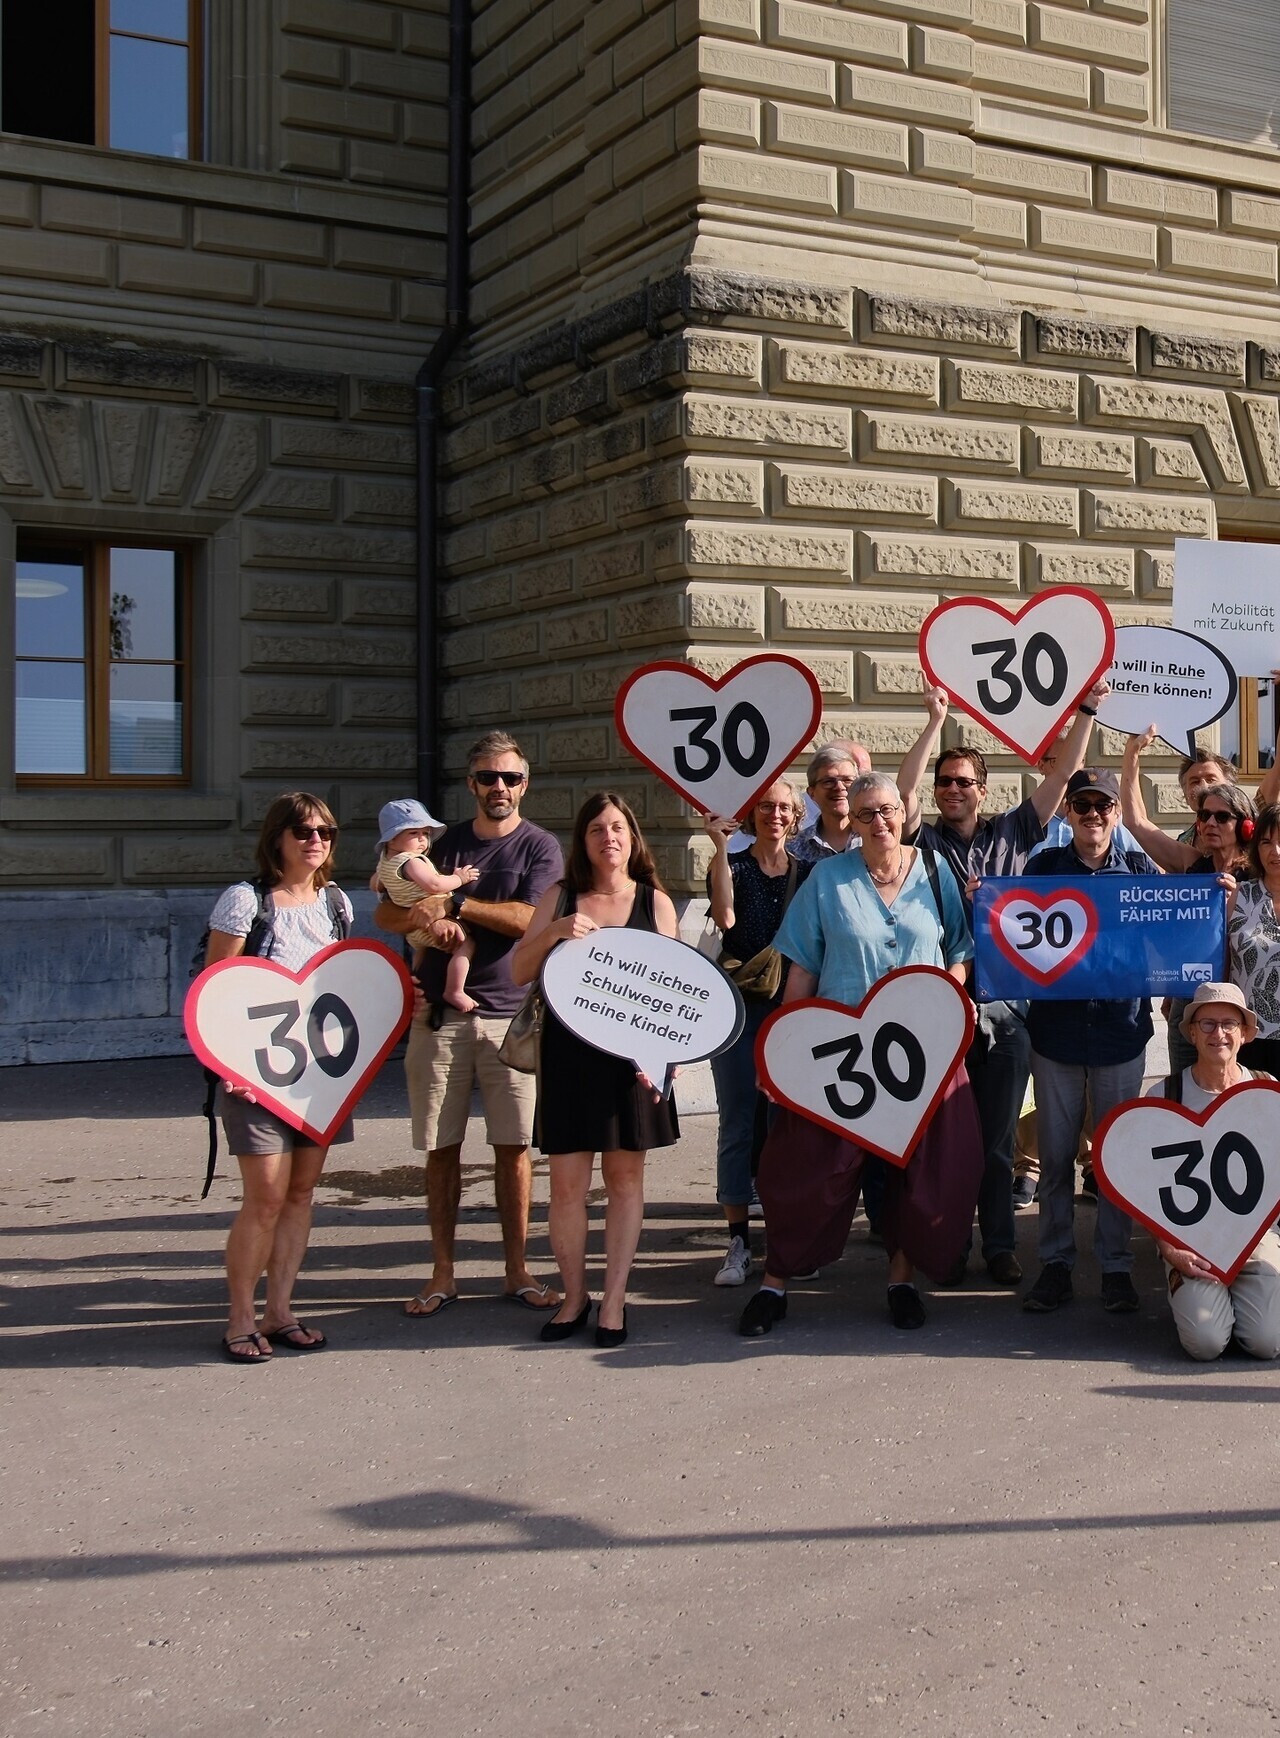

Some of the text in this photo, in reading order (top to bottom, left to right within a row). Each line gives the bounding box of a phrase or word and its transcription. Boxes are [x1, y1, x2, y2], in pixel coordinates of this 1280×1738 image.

[1193, 617, 1275, 633] mit Zukunft
[1211, 602, 1275, 618] Mobilität
[971, 631, 1068, 715] 30
[1122, 660, 1147, 672] will
[1151, 662, 1164, 674] in
[1168, 663, 1206, 678] Ruhe
[1153, 683, 1212, 699] können!
[669, 701, 770, 782] 30
[1119, 886, 1211, 903] RÜCKSICHT
[1120, 906, 1211, 922] FÄHRT MIT!
[1015, 910, 1073, 950] 30
[588, 946, 710, 1000] Ich will sichere
[1184, 969, 1212, 981] VCS
[582, 970, 703, 1023] Schulwege für
[247, 992, 360, 1088] 30
[573, 995, 693, 1046] meine Kinder!
[811, 1021, 927, 1120] 30
[1151, 1131, 1265, 1226] 30
